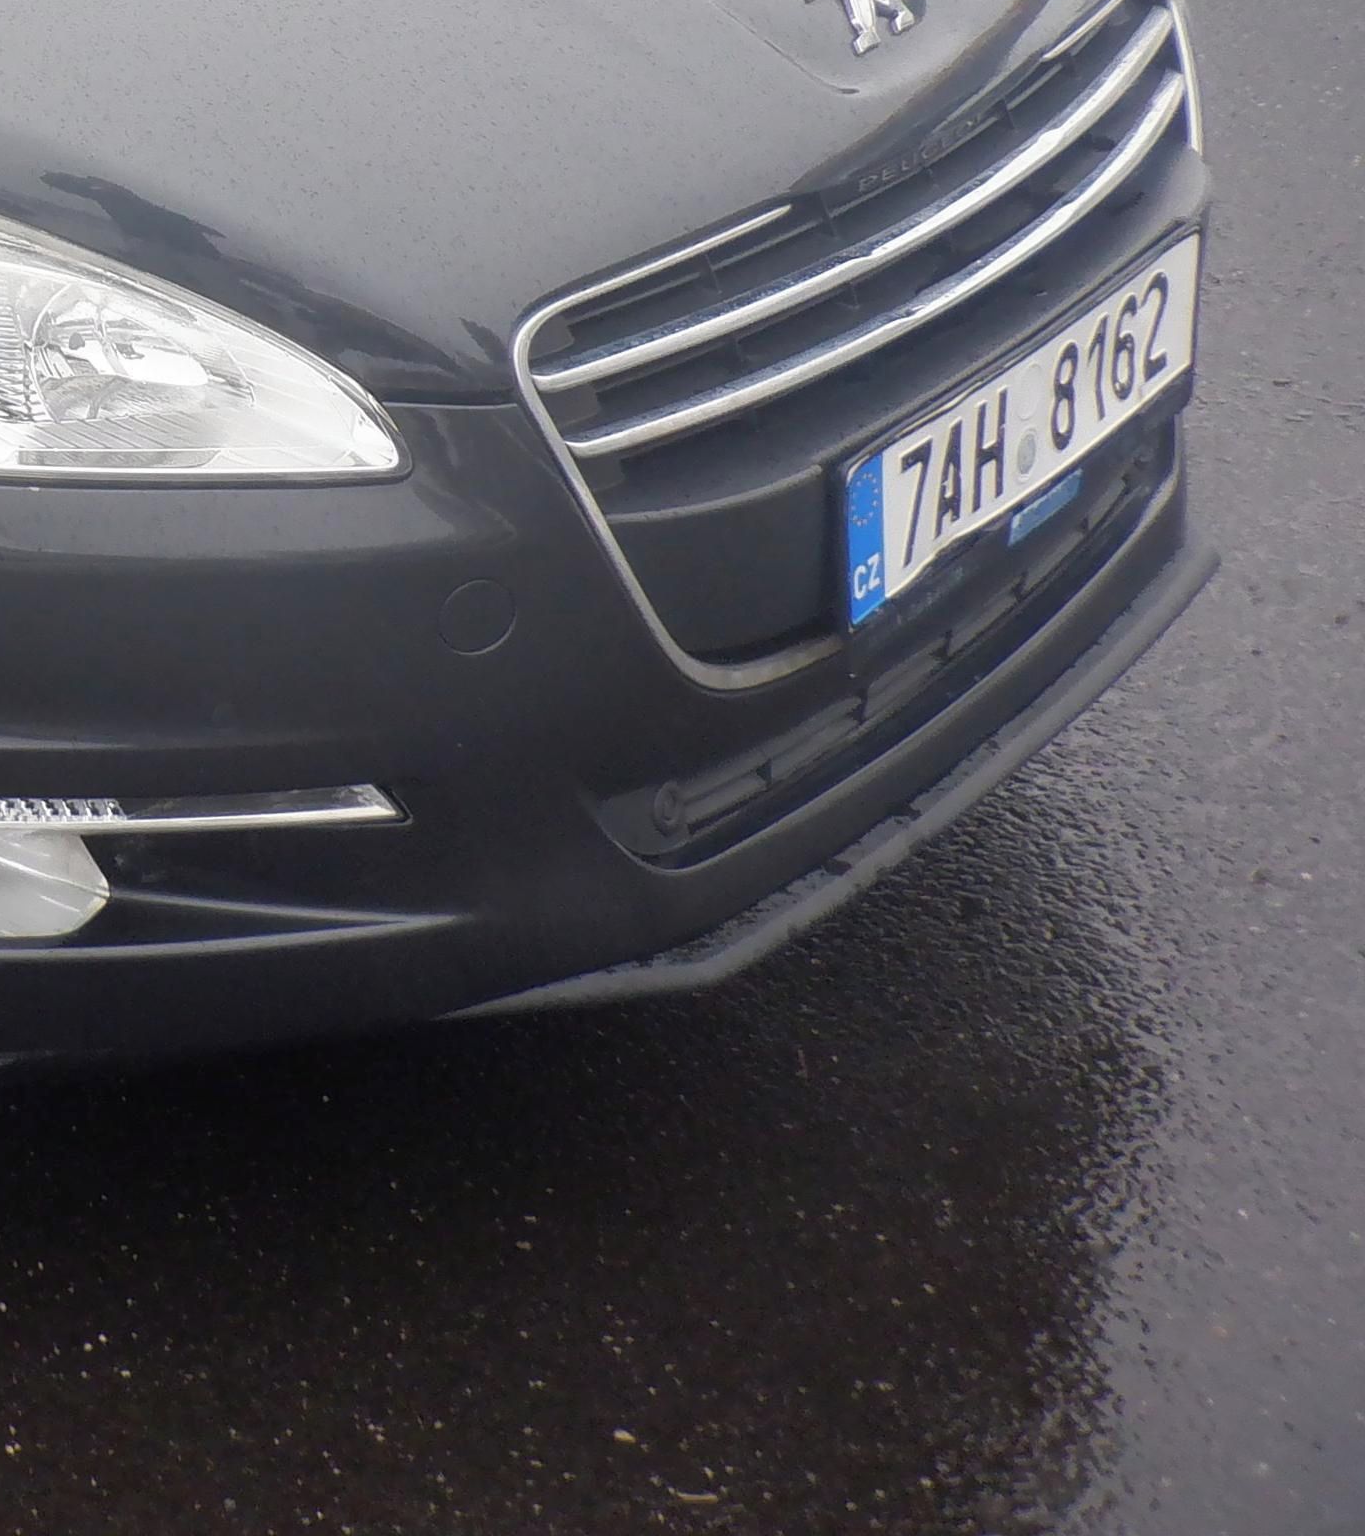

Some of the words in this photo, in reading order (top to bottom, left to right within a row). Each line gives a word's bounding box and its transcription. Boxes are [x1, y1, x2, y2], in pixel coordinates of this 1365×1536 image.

[853, 552, 882, 600] CZ
[897, 385, 1009, 571] 7AH
[1049, 269, 1170, 452] 8162
